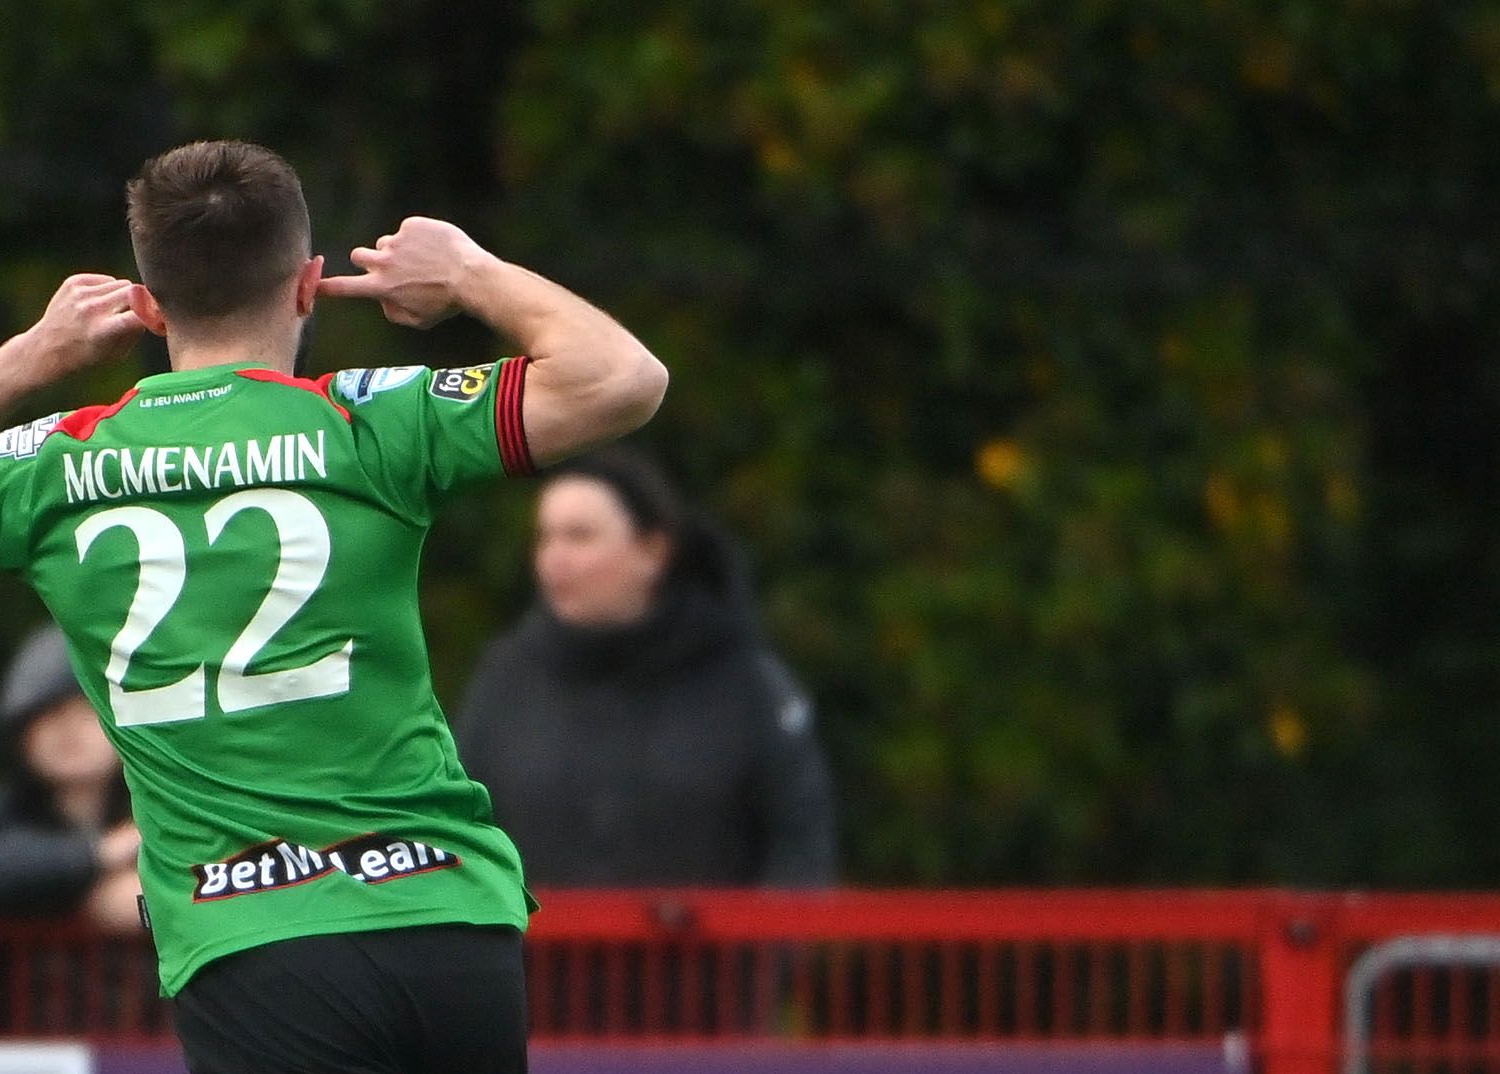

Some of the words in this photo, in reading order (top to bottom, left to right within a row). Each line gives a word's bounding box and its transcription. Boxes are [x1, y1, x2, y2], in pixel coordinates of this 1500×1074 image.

[140, 398, 152, 408] LE
[154, 396, 171, 406] JEU
[173, 390, 205, 404] AVANT
[207, 384, 232, 397] TOUT
[63, 430, 327, 504] MCMENAMIN
[74, 488, 353, 727] 22
[200, 854, 276, 895] Bet
